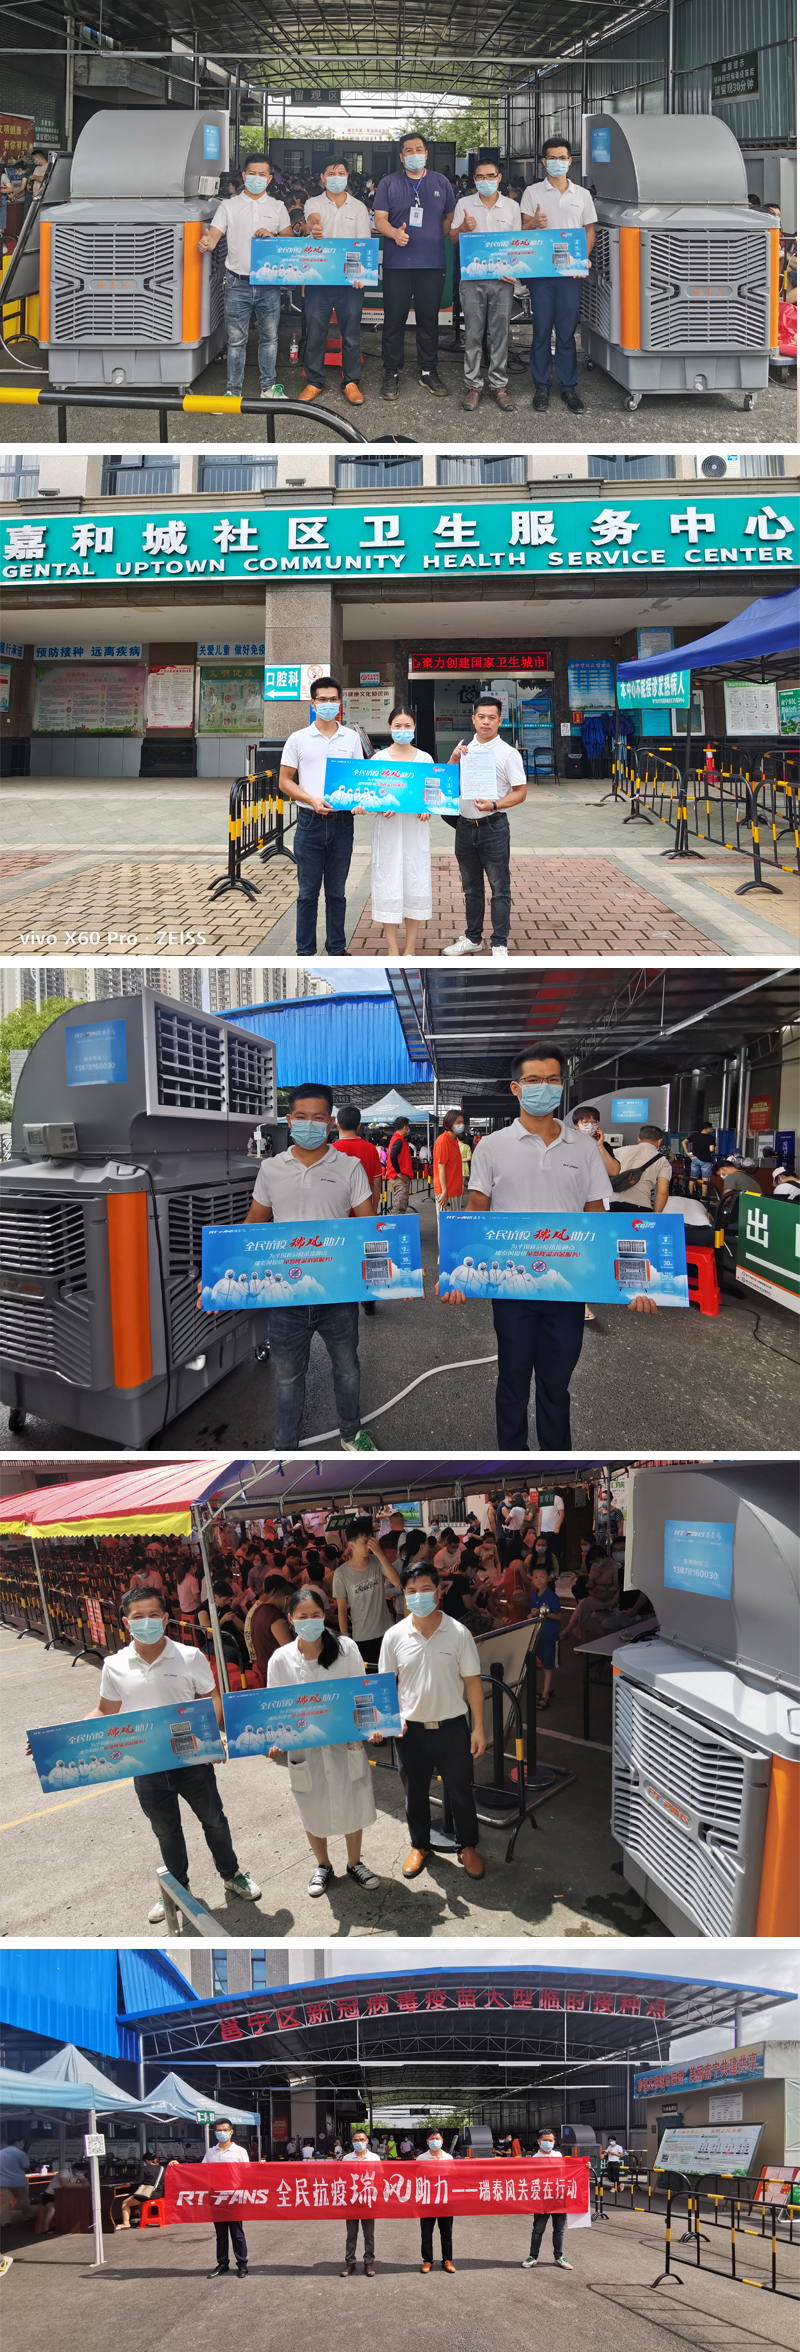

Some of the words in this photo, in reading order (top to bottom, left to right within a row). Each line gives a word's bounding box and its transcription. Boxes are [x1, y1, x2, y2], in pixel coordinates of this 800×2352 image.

[722, 58, 745, 72] 温馨提示
[714, 78, 754, 96] 请留观30分钟
[294, 89, 338, 101] 留观区
[4, 140, 28, 151] 有你有我
[3, 505, 796, 561] 嘉和城社区卫生服务中心
[2, 562, 96, 579] GENTAL
[115, 558, 225, 576] UPTOWN
[243, 554, 406, 572] COMMUNITY
[423, 552, 526, 570] HEALTH
[548, 549, 666, 567] SERVICE
[684, 546, 794, 564] CENTER
[36, 647, 84, 658] 预防接种
[91, 646, 141, 657] 远离疾病
[199, 645, 231, 656] 关爱儿童
[413, 656, 546, 669] 心聚力创建国家卫生城市
[208, 669, 255, 678] 文明健康
[266, 670, 299, 688] 口腔科
[74, 1062, 116, 1072] 13878160030
[673, 1566, 718, 1580] 13878160030
[219, 1987, 668, 2041] 邕宁区新冠病毒疫苗大型临时接种点
[689, 2052, 757, 2083] 美丽南宁共建共享
[176, 2190, 208, 2206] RT
[211, 2188, 269, 2205] FANS
